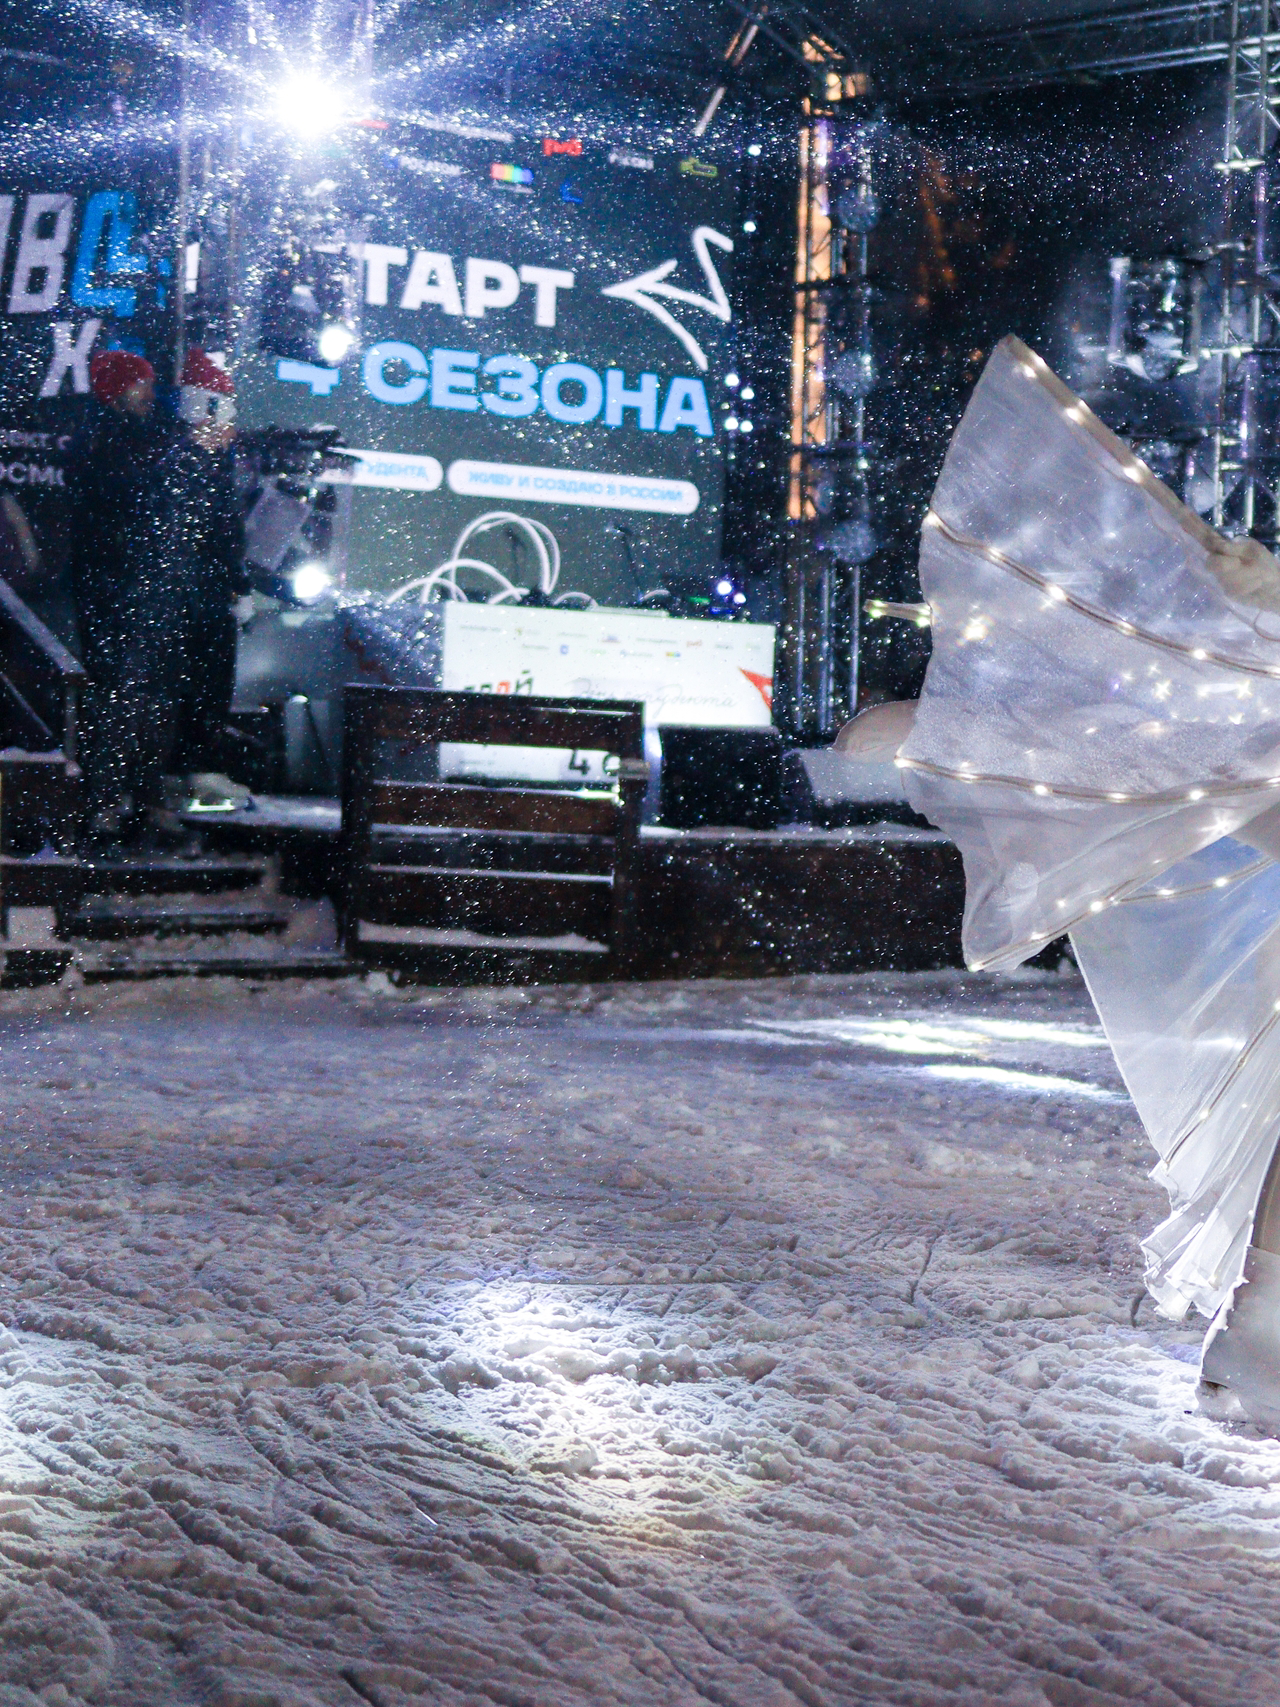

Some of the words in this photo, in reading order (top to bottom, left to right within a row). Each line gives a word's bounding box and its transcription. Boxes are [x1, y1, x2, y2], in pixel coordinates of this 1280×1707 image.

[346, 242, 575, 329] ТАРТ
[361, 341, 715, 438] СЕЗОНА
[469, 471, 514, 488] ЖИВУ
[518, 475, 530, 488] И
[533, 477, 602, 495] СОЗДАЮ
[619, 486, 684, 502] РОССИИ
